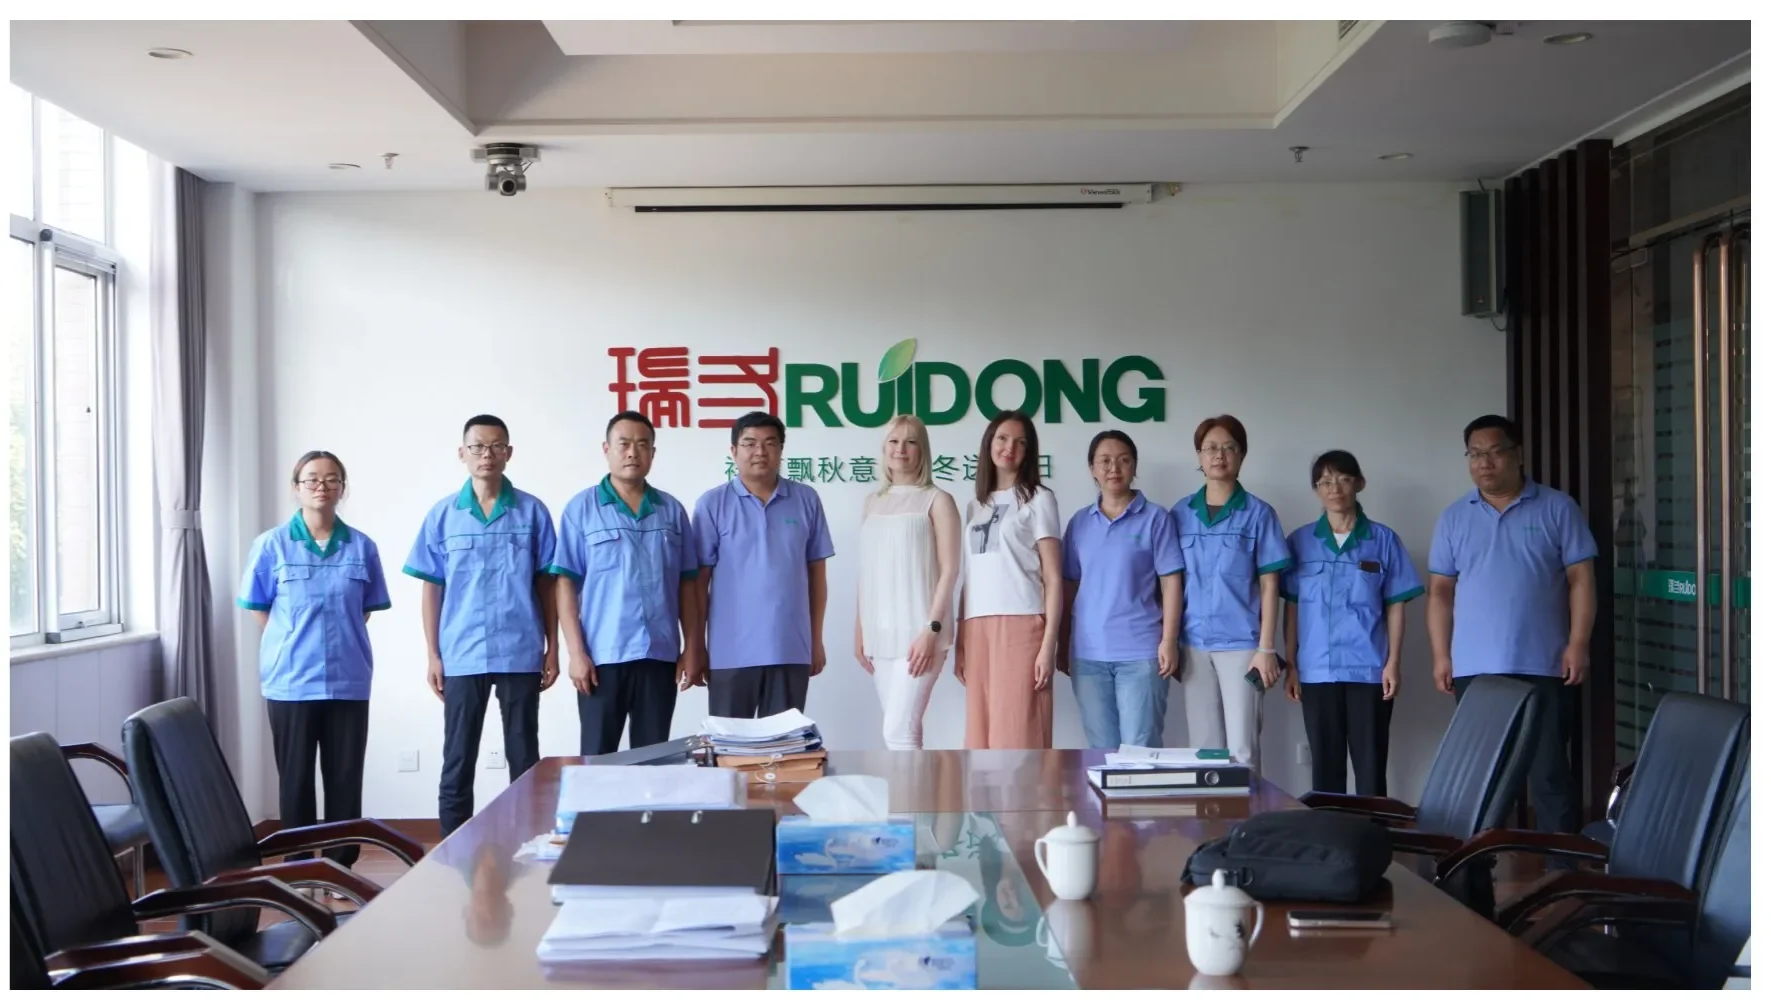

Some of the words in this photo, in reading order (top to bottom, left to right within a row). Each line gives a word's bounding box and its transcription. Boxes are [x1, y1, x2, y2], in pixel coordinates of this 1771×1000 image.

[785, 338, 1167, 428] RUIDONG
[724, 455, 878, 483] 飘秋意
